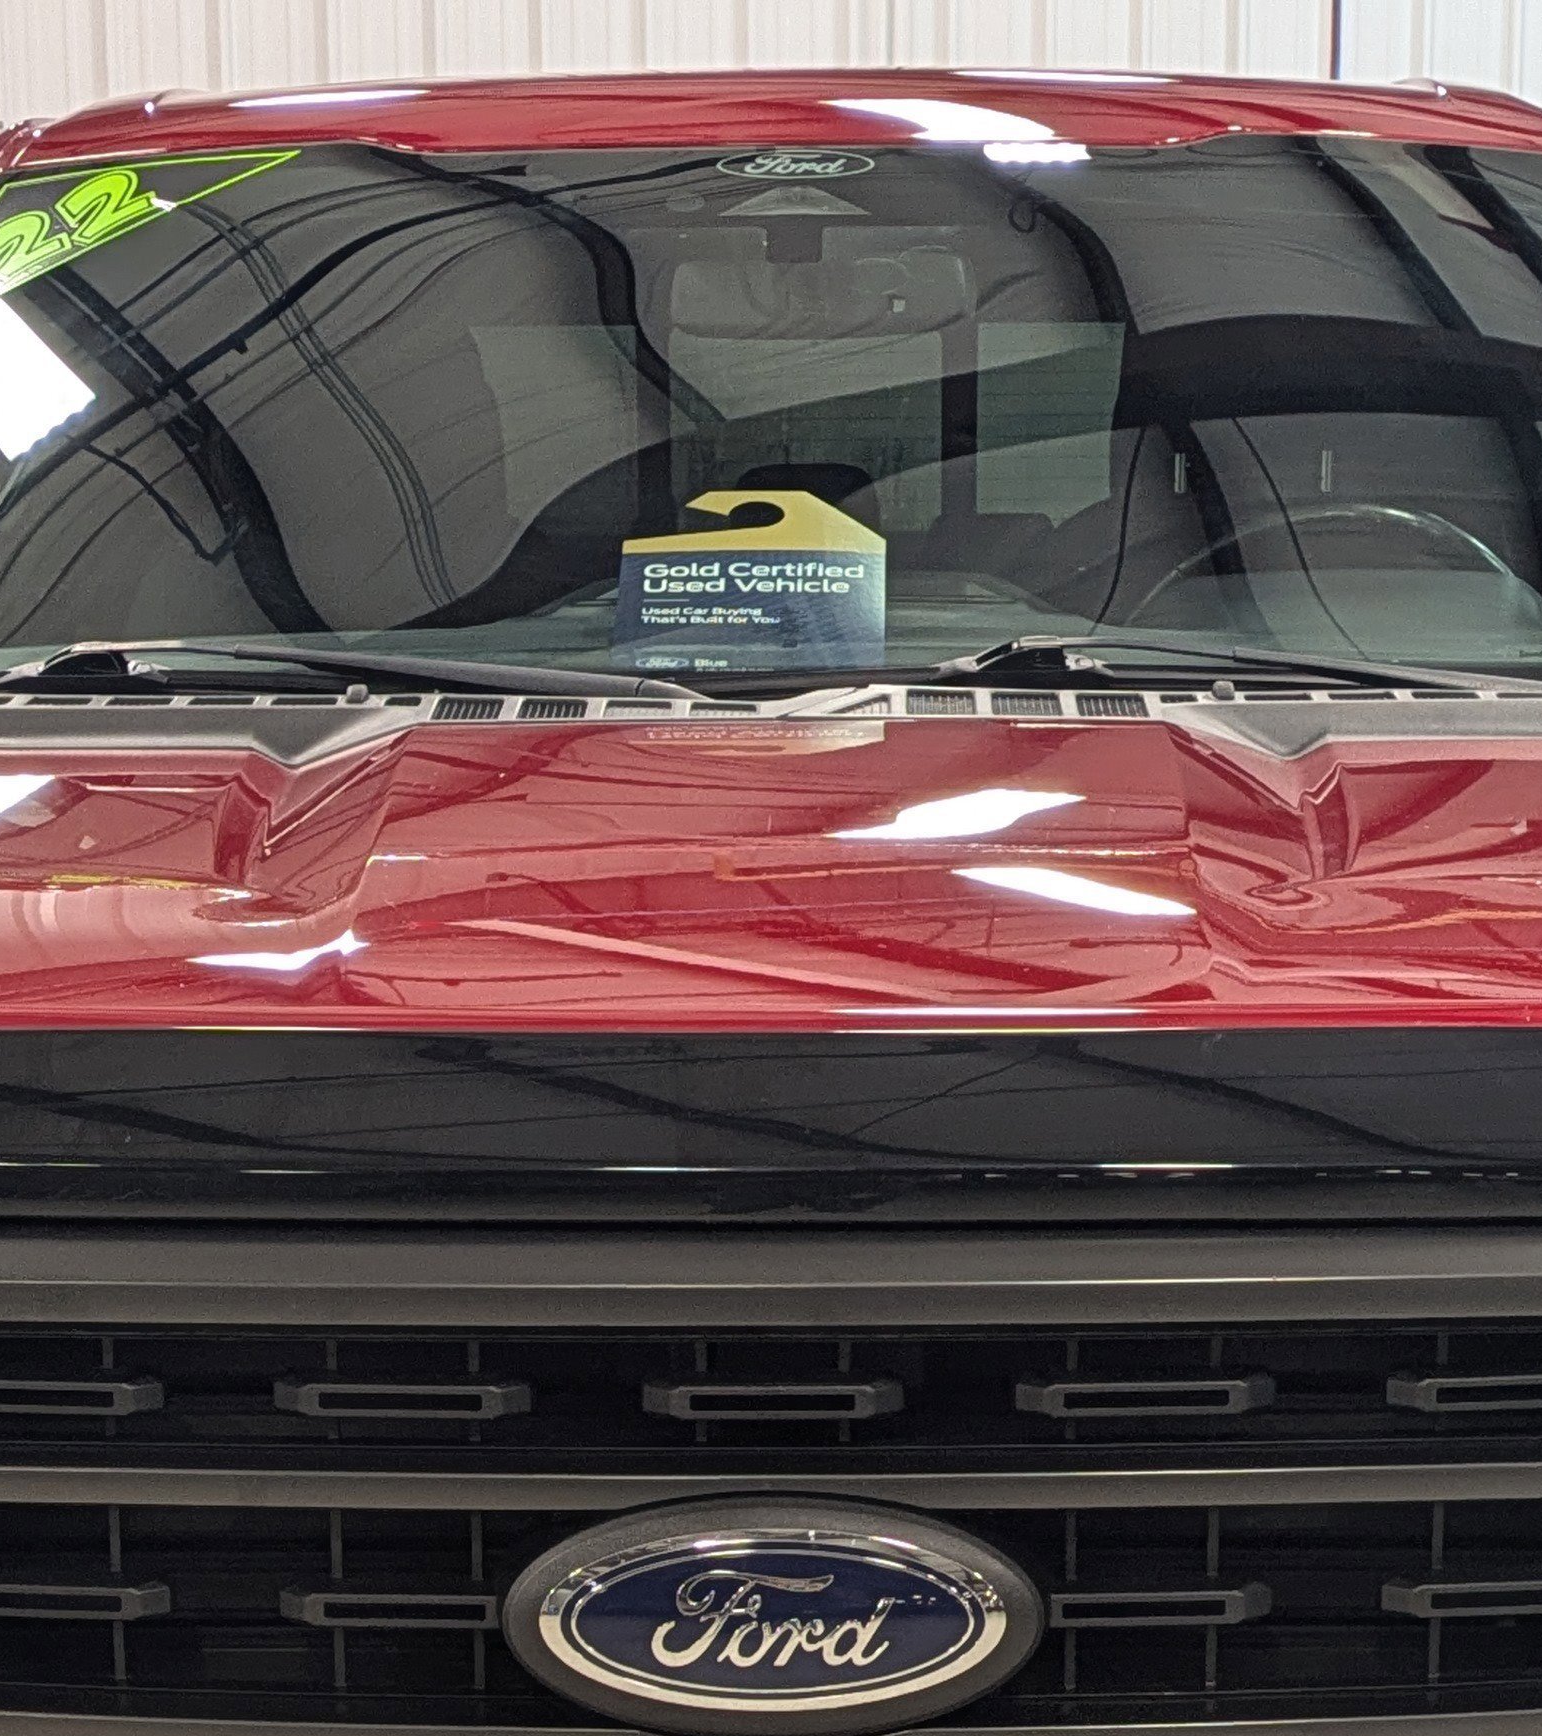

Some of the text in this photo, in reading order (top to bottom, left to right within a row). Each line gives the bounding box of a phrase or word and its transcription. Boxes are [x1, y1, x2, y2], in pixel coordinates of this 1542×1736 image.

[743, 153, 847, 175] Ford
[643, 562, 865, 579] Gold Certified
[643, 577, 851, 594] Used Vehicle
[641, 607, 763, 616] Used Car Buying
[641, 615, 781, 624] That's Built for You
[650, 1569, 897, 1668] Ford
